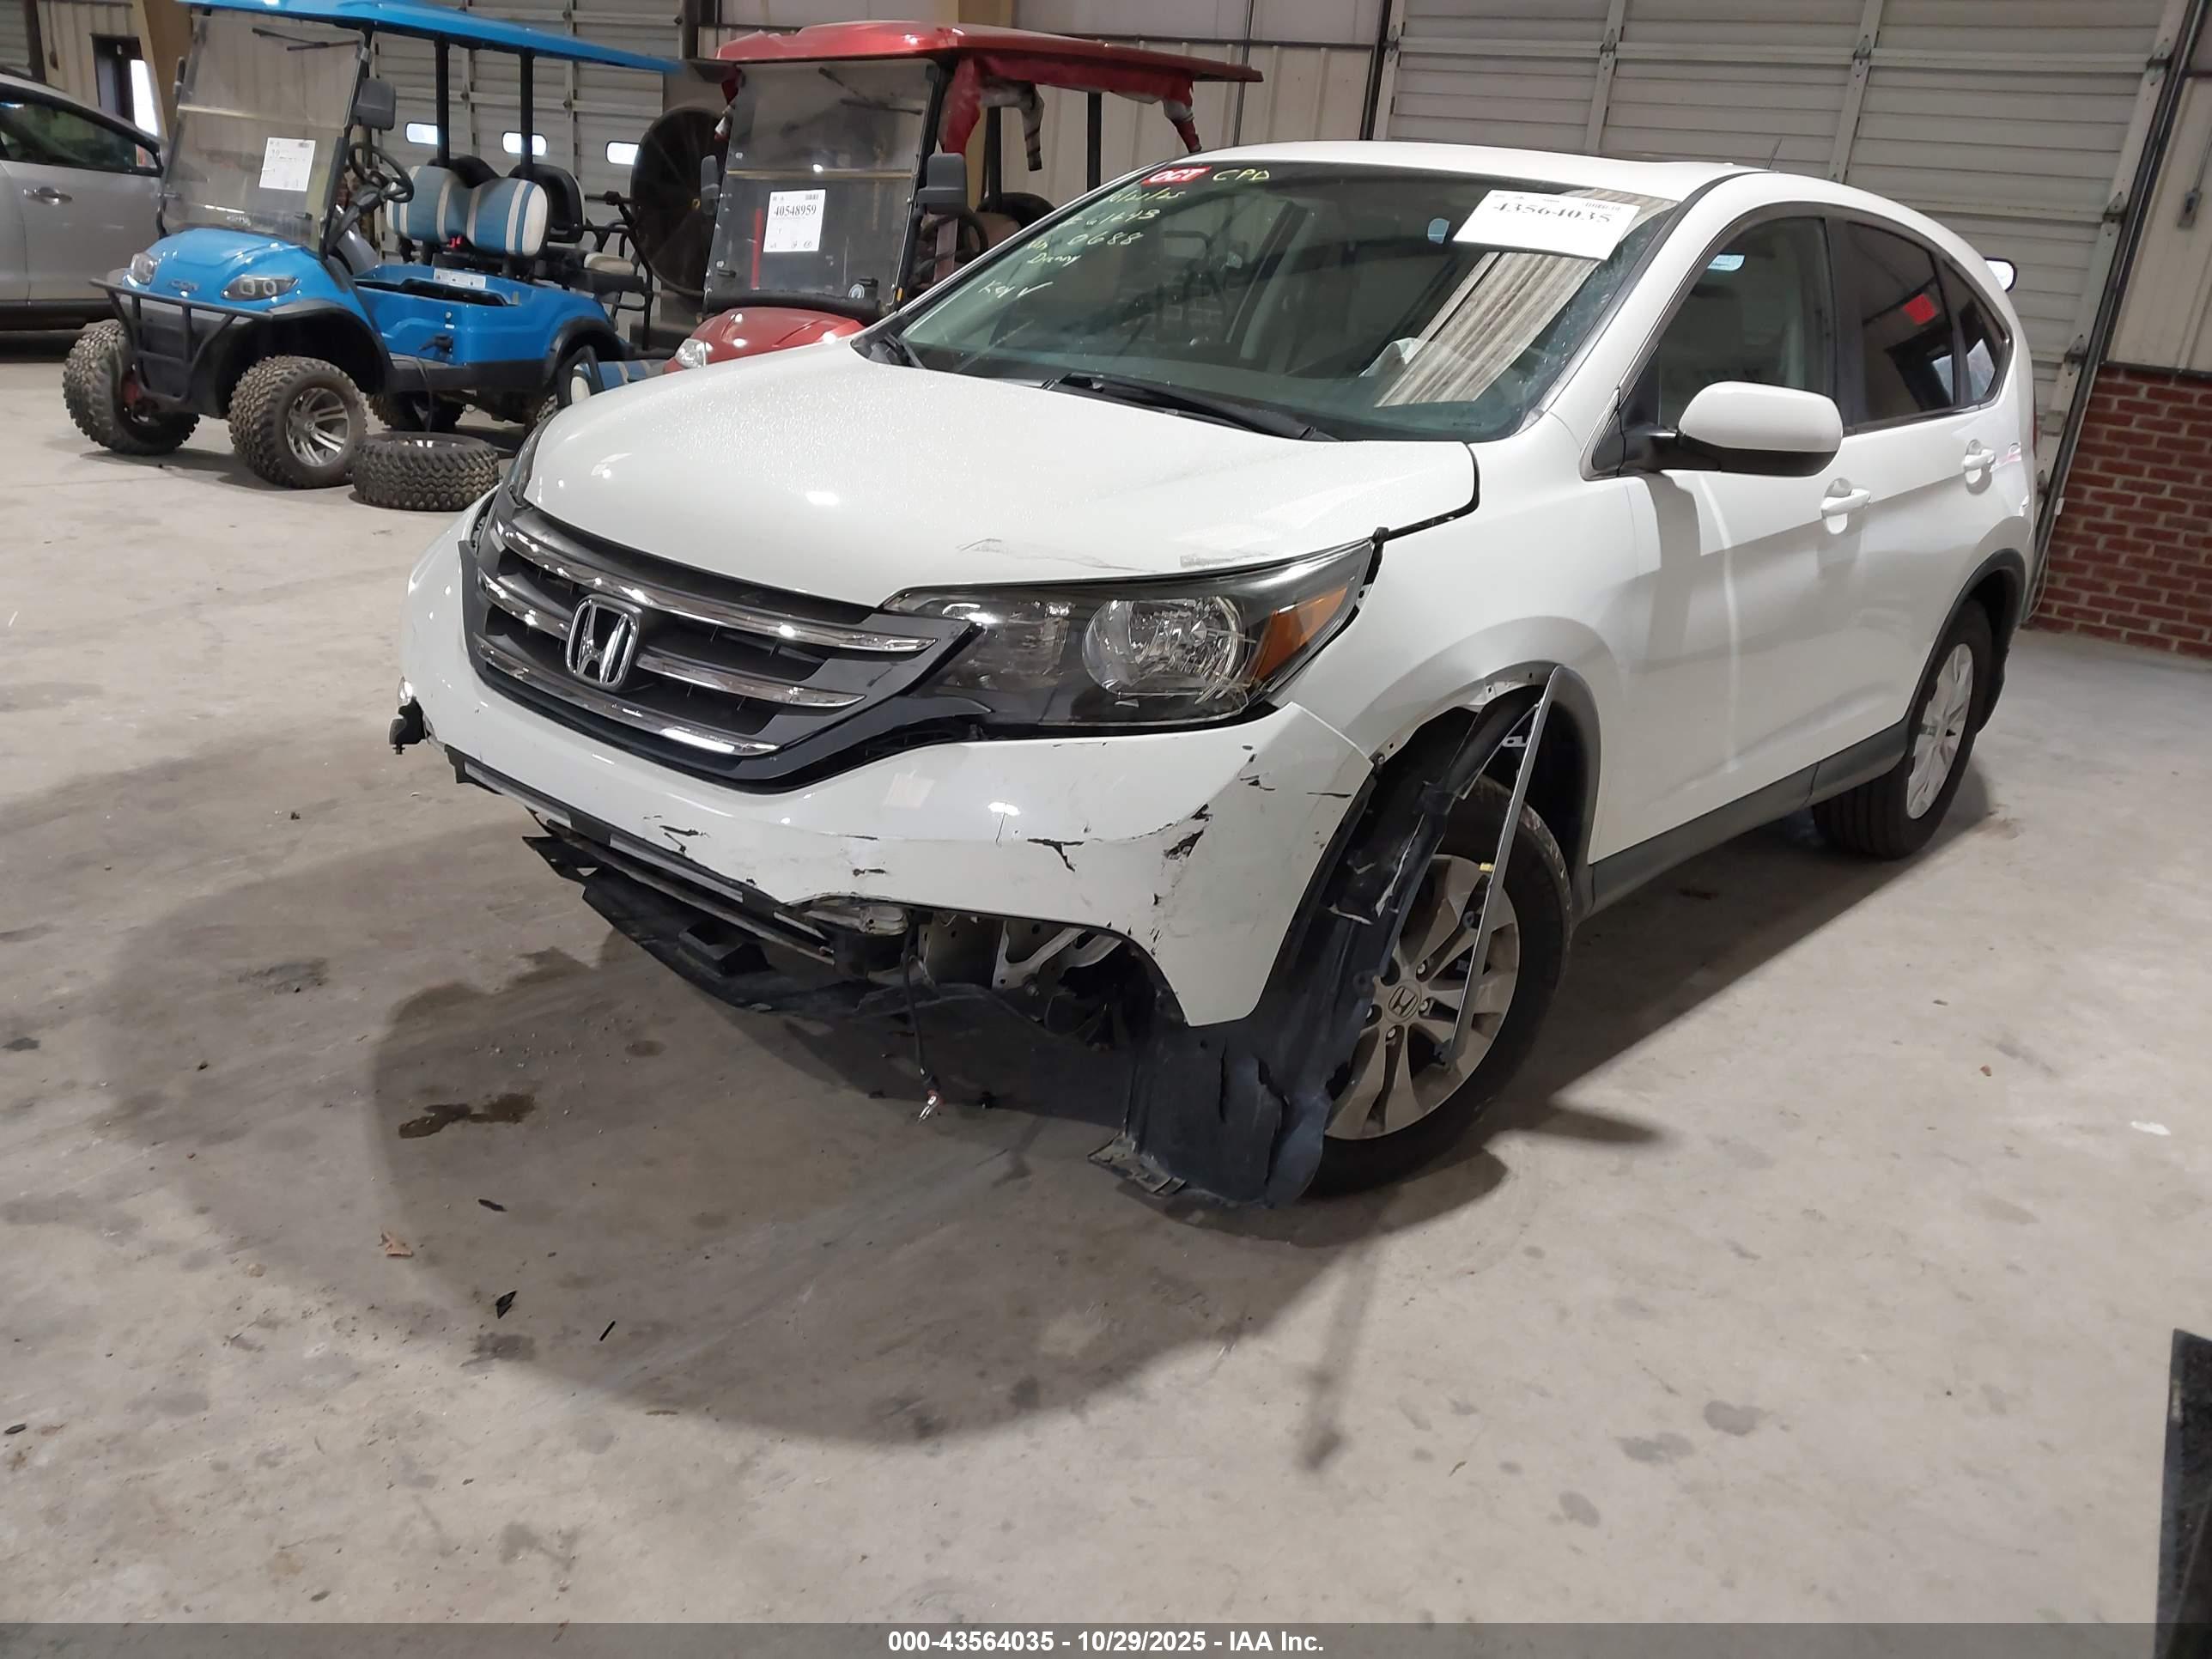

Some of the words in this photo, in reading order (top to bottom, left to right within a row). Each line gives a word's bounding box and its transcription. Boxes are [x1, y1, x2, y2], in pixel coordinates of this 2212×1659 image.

[1212, 168, 1271, 181] CPD
[774, 204, 817, 216] 40548959
[1493, 202, 1614, 222] 43564035
[1067, 231, 1145, 246] 0688
